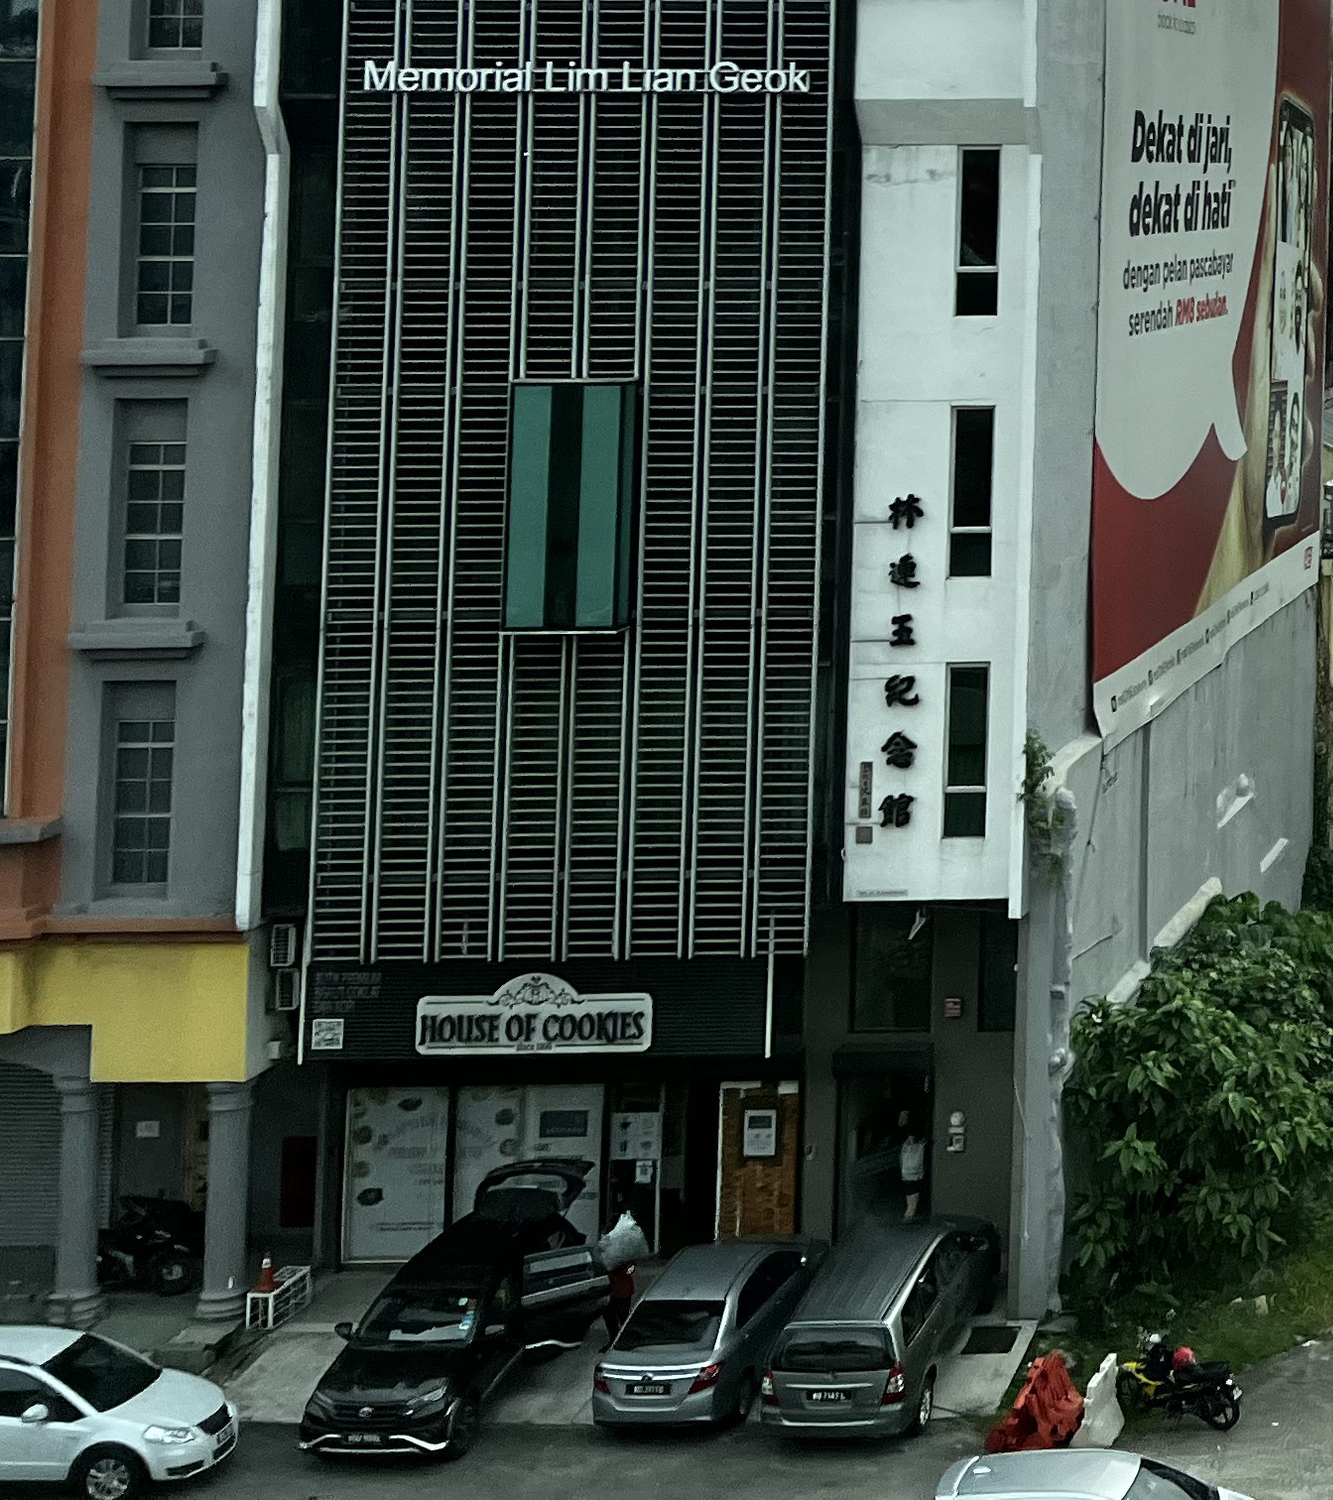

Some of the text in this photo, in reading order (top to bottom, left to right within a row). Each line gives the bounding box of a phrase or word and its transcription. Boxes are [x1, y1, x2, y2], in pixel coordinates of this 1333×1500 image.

[363, 59, 811, 94] Memorial Lim Lian Geok
[1131, 109, 1233, 174] Dekat di jari,
[1129, 180, 1181, 237] dekat
[1184, 180, 1201, 232] di
[1122, 248, 1234, 292] dengan pelan pascabayar
[1128, 300, 1174, 337] serendah
[418, 1010, 646, 1046] HOUSE OF COOKIES
